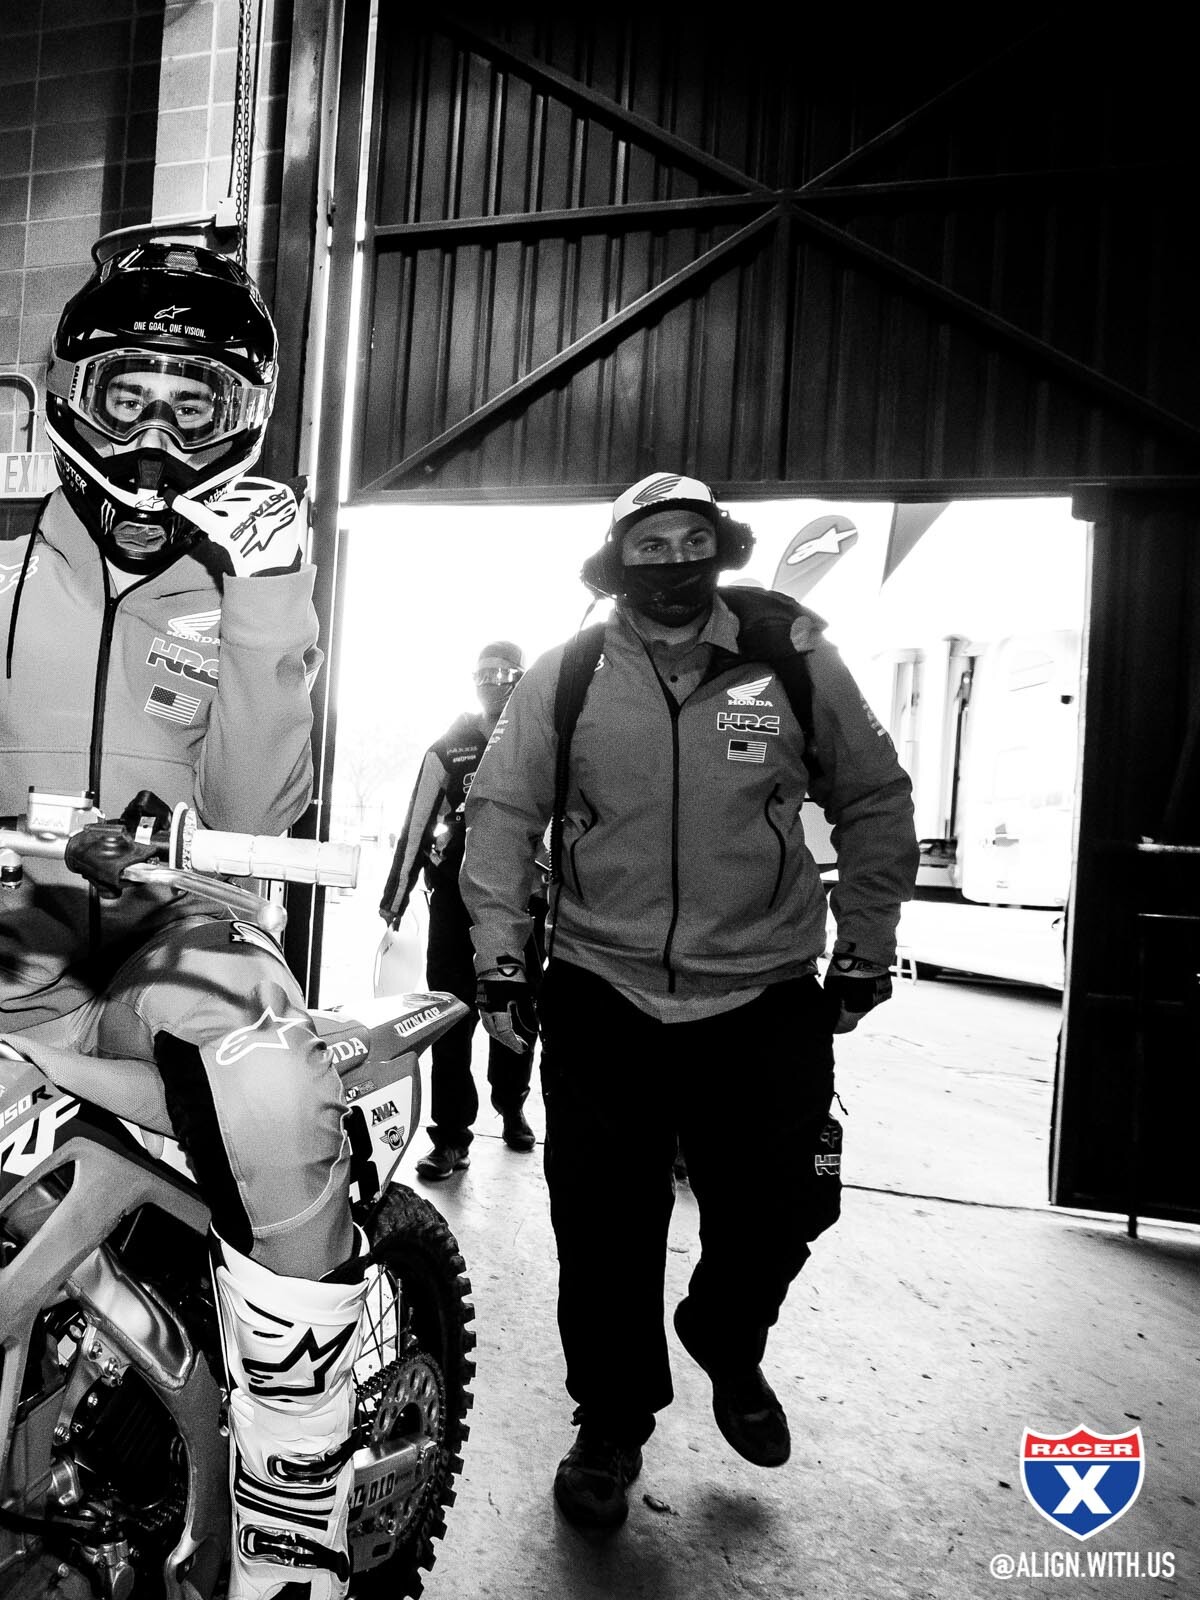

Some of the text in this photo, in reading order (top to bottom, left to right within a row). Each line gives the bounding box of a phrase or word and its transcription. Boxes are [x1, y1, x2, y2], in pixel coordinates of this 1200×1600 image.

[134, 321, 147, 331] ONE
[169, 323, 183, 334] ONE
[69, 365, 81, 402] OAKLEY
[4, 455, 52, 493] EXIT
[165, 630, 221, 645] HONDA
[727, 700, 774, 708] HONDA
[717, 712, 781, 736] HRC
[394, 1006, 442, 1035] DUNLOP
[371, 1100, 400, 1127] AMA
